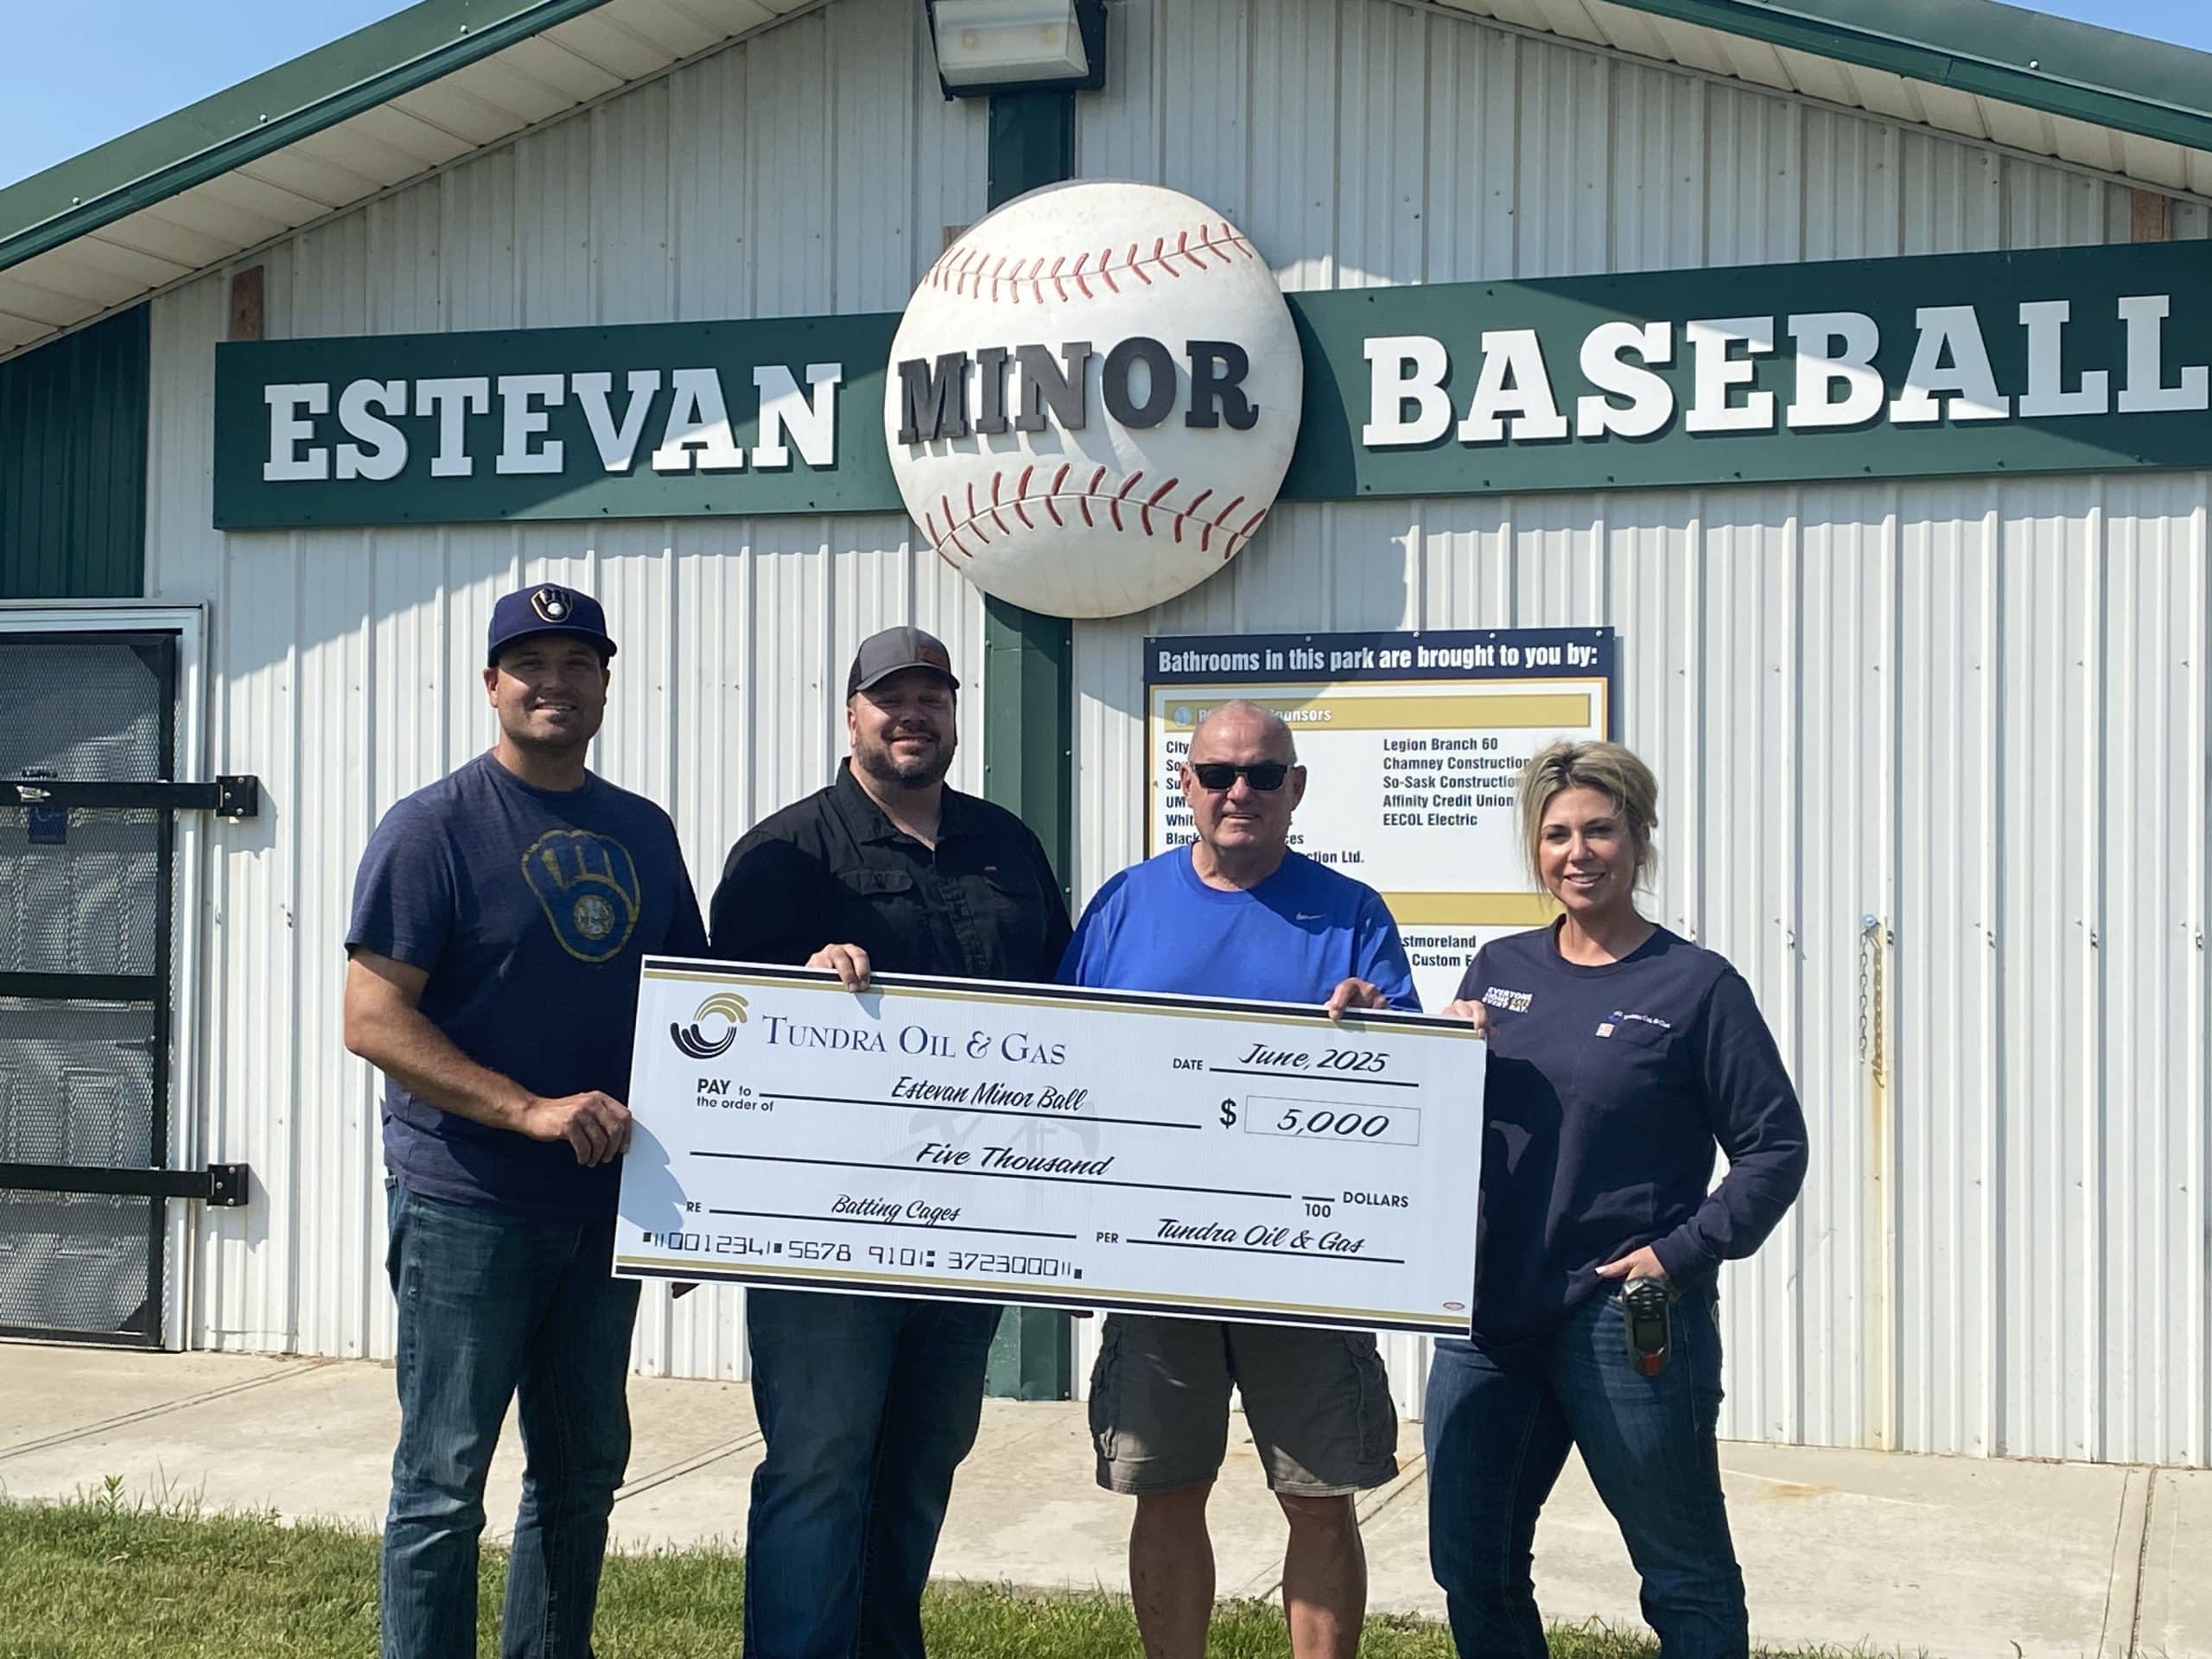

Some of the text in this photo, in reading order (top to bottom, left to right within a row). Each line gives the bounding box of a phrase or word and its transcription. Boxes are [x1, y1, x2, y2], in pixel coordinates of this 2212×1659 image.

[263, 294, 2209, 481] ESTEVAN MINOR BASEBALL
[1158, 642, 1598, 673] Bathrooms in this park are brought to you by:
[1166, 741, 1190, 754] City
[1383, 737, 1498, 753] Legion Branch 60
[1383, 757, 1444, 771] Chamney
[1382, 775, 1515, 788] So-Sask Constructio
[1382, 794, 1514, 808] Affinity Credit Union
[1166, 813, 1196, 827] Whit
[1382, 813, 1478, 826] EECOL Electric
[1342, 850, 1364, 863] Ltd.
[1402, 935, 1477, 948] stmoreland
[1412, 953, 1460, 967] Custom
[761, 1014, 1066, 1065] TUNDRA OIL & GAS
[1173, 1042, 1389, 1073] DATE June, 2025
[696, 1076, 1090, 1112] PAY to Estevan Minor Ball
[696, 1094, 774, 1112] the order of
[1219, 1096, 1390, 1138] $ 5,000
[916, 1143, 1115, 1177] Five Thousand
[1343, 1191, 1409, 1208] DOLLARS
[686, 1194, 962, 1226] RE Batting Cages
[1304, 1202, 1332, 1219] 100
[1096, 1217, 1366, 1254] PER Tundra Oil & Gas
[788, 1240, 852, 1262] 5678
